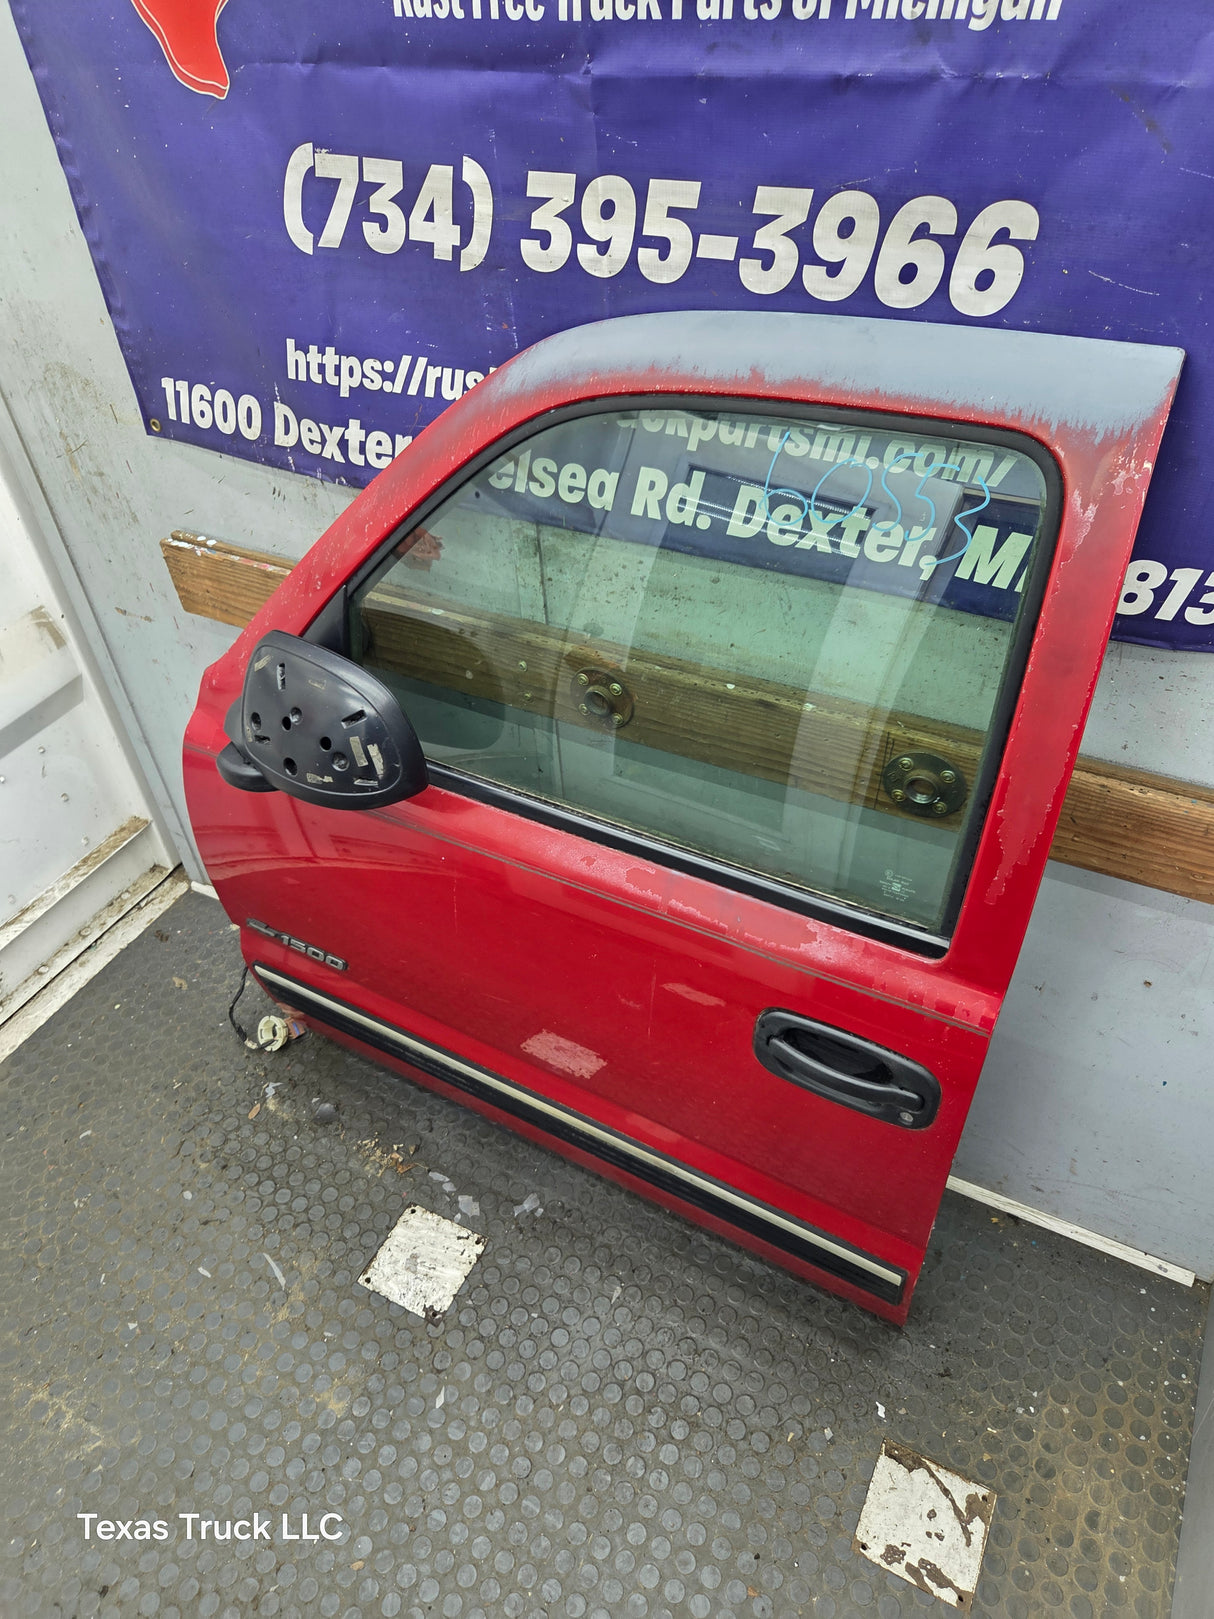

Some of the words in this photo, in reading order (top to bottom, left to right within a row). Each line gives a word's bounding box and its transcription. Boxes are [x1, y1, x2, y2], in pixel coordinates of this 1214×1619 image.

[283, 142, 493, 272] (734)
[519, 170, 1040, 317] 395-3966
[286, 338, 497, 401] https://rus
[161, 377, 262, 441] 11600
[630, 466, 712, 529] Rd.
[726, 484, 937, 581] Dexter,
[954, 524, 1033, 593] M
[280, 933, 346, 971] 1500
